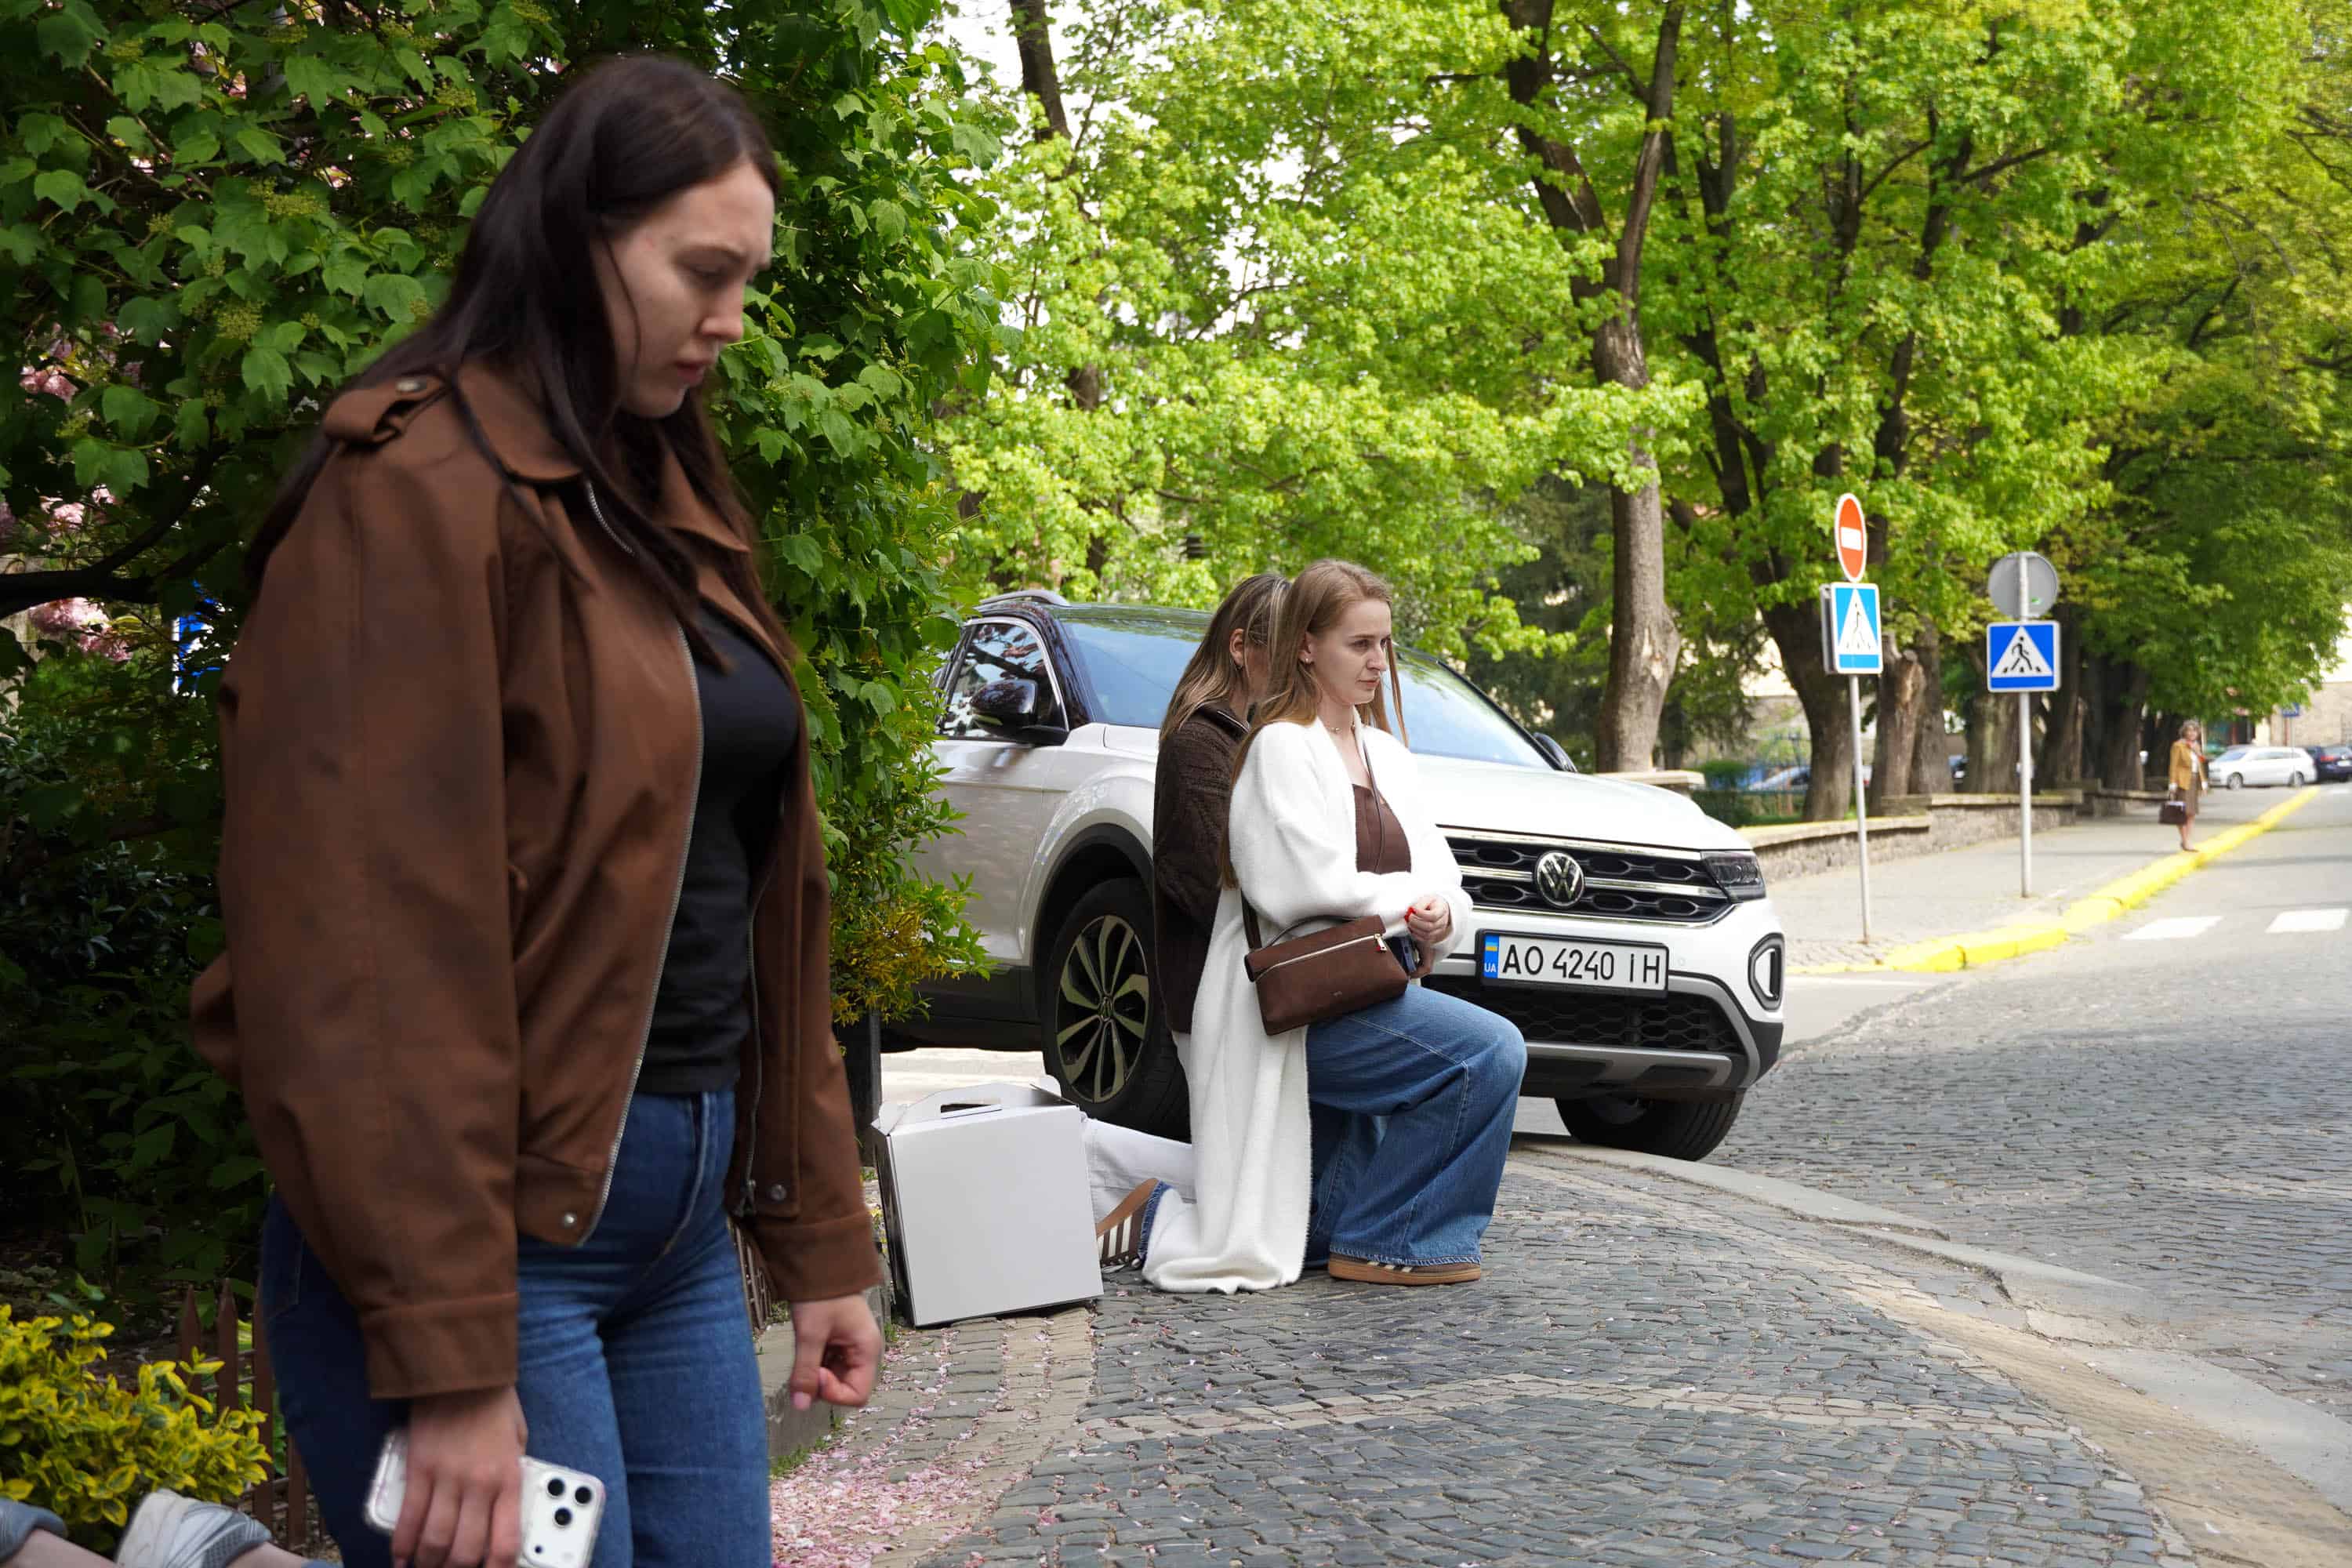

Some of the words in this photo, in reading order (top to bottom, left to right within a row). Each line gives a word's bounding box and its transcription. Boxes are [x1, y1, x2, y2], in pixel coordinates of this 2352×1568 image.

[1484, 963, 1496, 973] UA
[1502, 944, 1544, 975] AO
[1552, 948, 1614, 980] 4240
[1629, 953, 1661, 984] IH
